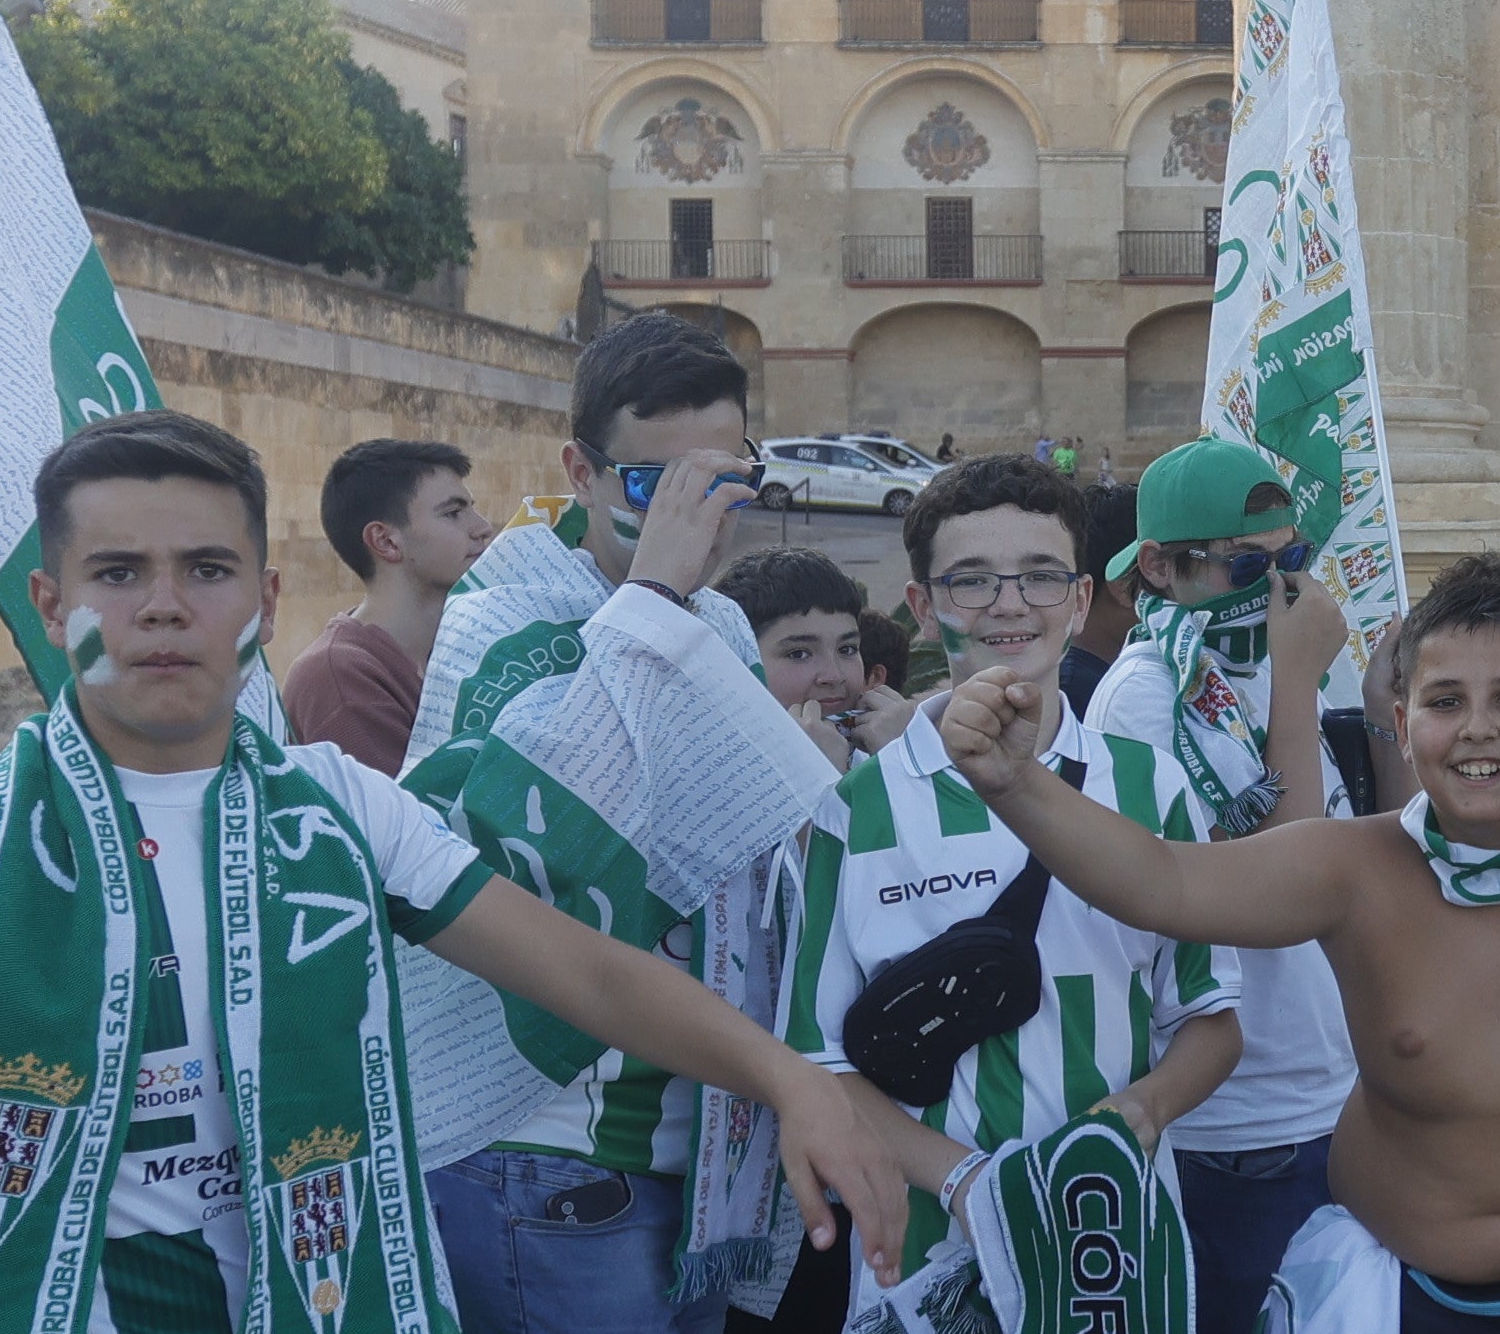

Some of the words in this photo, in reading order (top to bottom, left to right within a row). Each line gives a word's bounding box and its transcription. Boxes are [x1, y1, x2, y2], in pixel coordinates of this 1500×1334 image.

[1220, 592, 1271, 621] CÓRDO
[63, 744, 104, 803] CLUB
[95, 801, 130, 916] CÓRDOBA
[223, 814, 248, 845] DE
[223, 845, 255, 939] FÚTBOL
[879, 868, 998, 906] GIVOVA
[105, 967, 132, 1037] S.A.D.
[228, 943, 253, 1012] S.A.D.
[86, 1037, 124, 1138] FÚTBOL
[134, 1085, 204, 1110] RDOBA
[365, 1035, 392, 1141] CÓRDOBA
[78, 1140, 103, 1178] DE
[374, 1144, 400, 1203] CLUB
[62, 1178, 96, 1245] CLUB
[381, 1204, 404, 1233] DE
[385, 1233, 417, 1327] FÚTBOL
